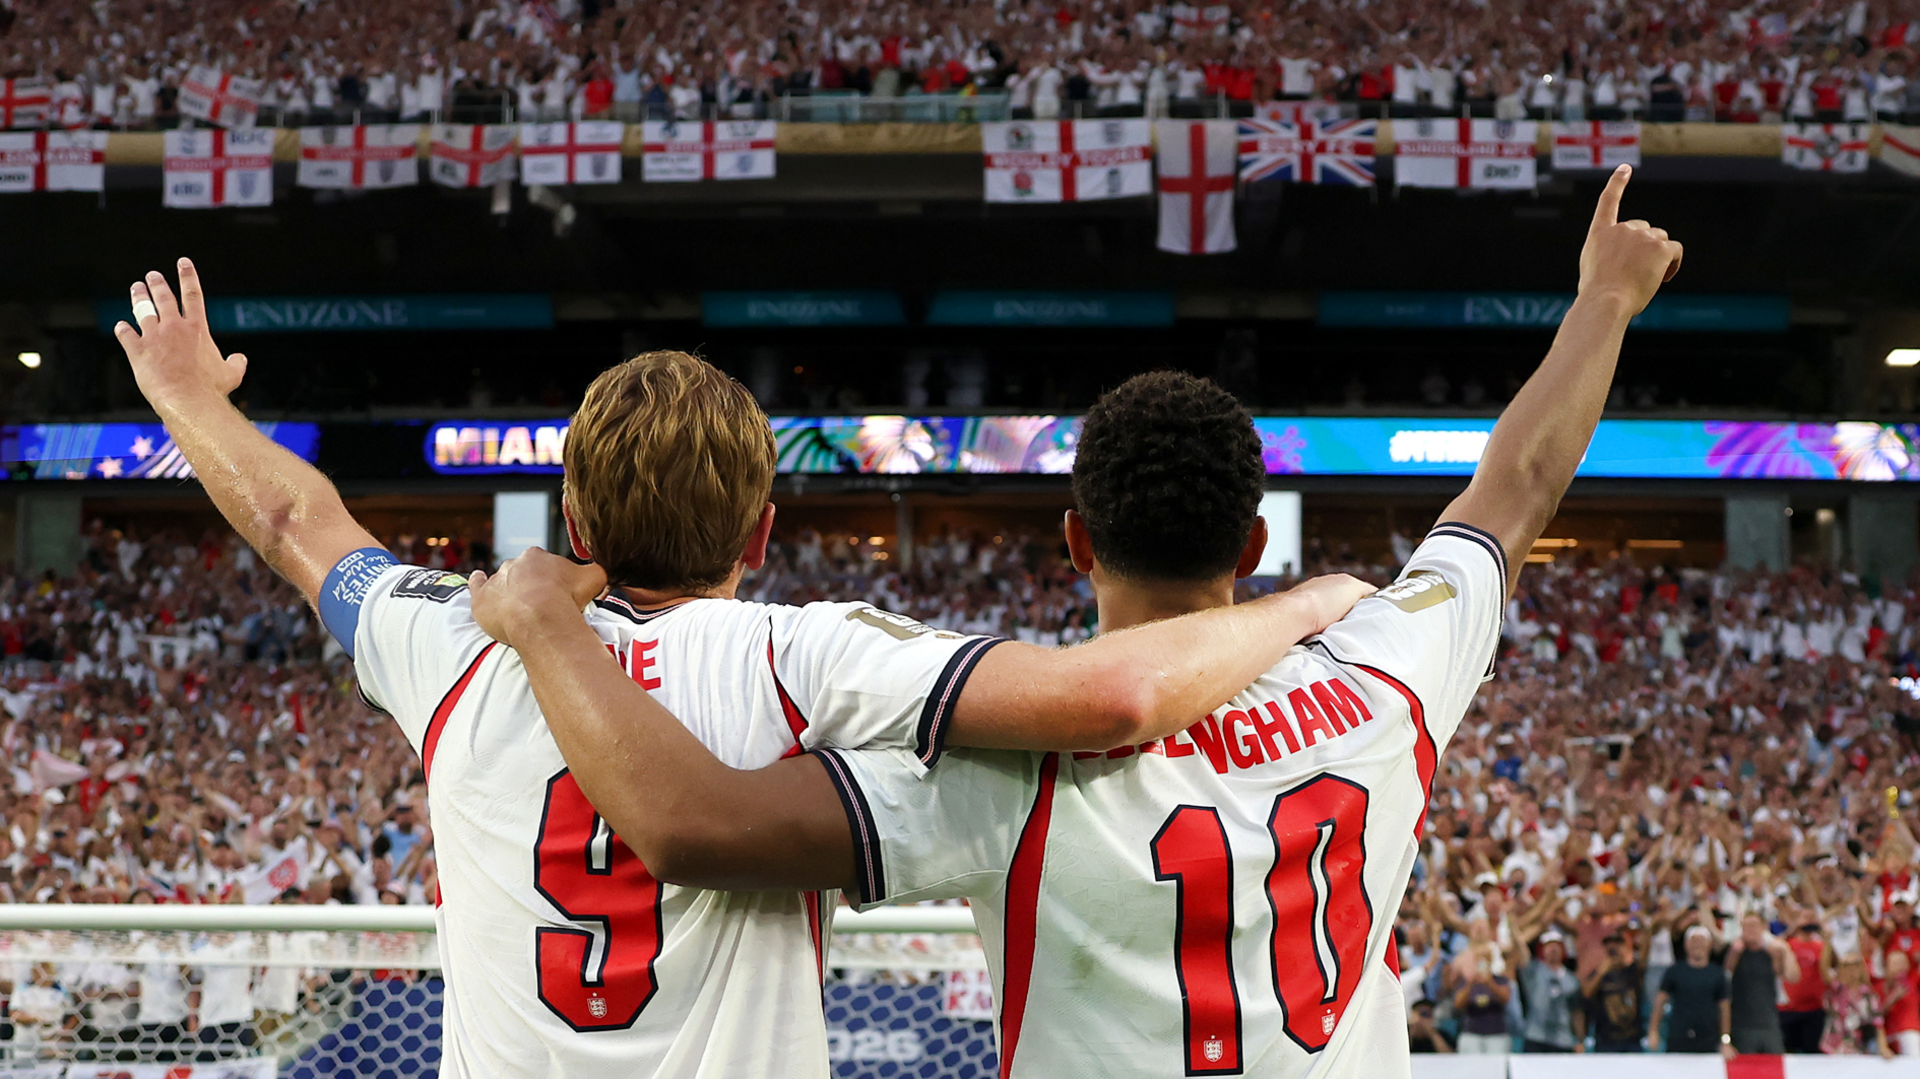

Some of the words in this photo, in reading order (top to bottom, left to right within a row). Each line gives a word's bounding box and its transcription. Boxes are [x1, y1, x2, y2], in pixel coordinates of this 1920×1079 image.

[1258, 139, 1317, 153] BURY
[1326, 139, 1355, 154] FC
[1401, 143, 1497, 156] SUNDERLAND
[236, 301, 408, 328] ENDZONE
[1463, 298, 1570, 324] ENDZ
[434, 427, 567, 465] MIAM
[337, 552, 364, 572] FIFA
[365, 555, 391, 565] the
[332, 561, 369, 602] World
[342, 563, 394, 604] UNITES
[1073, 678, 1373, 774] NGHAM
[534, 766, 664, 1033] 9
[1149, 772, 1374, 1077] 10
[827, 1030, 922, 1061] 026
